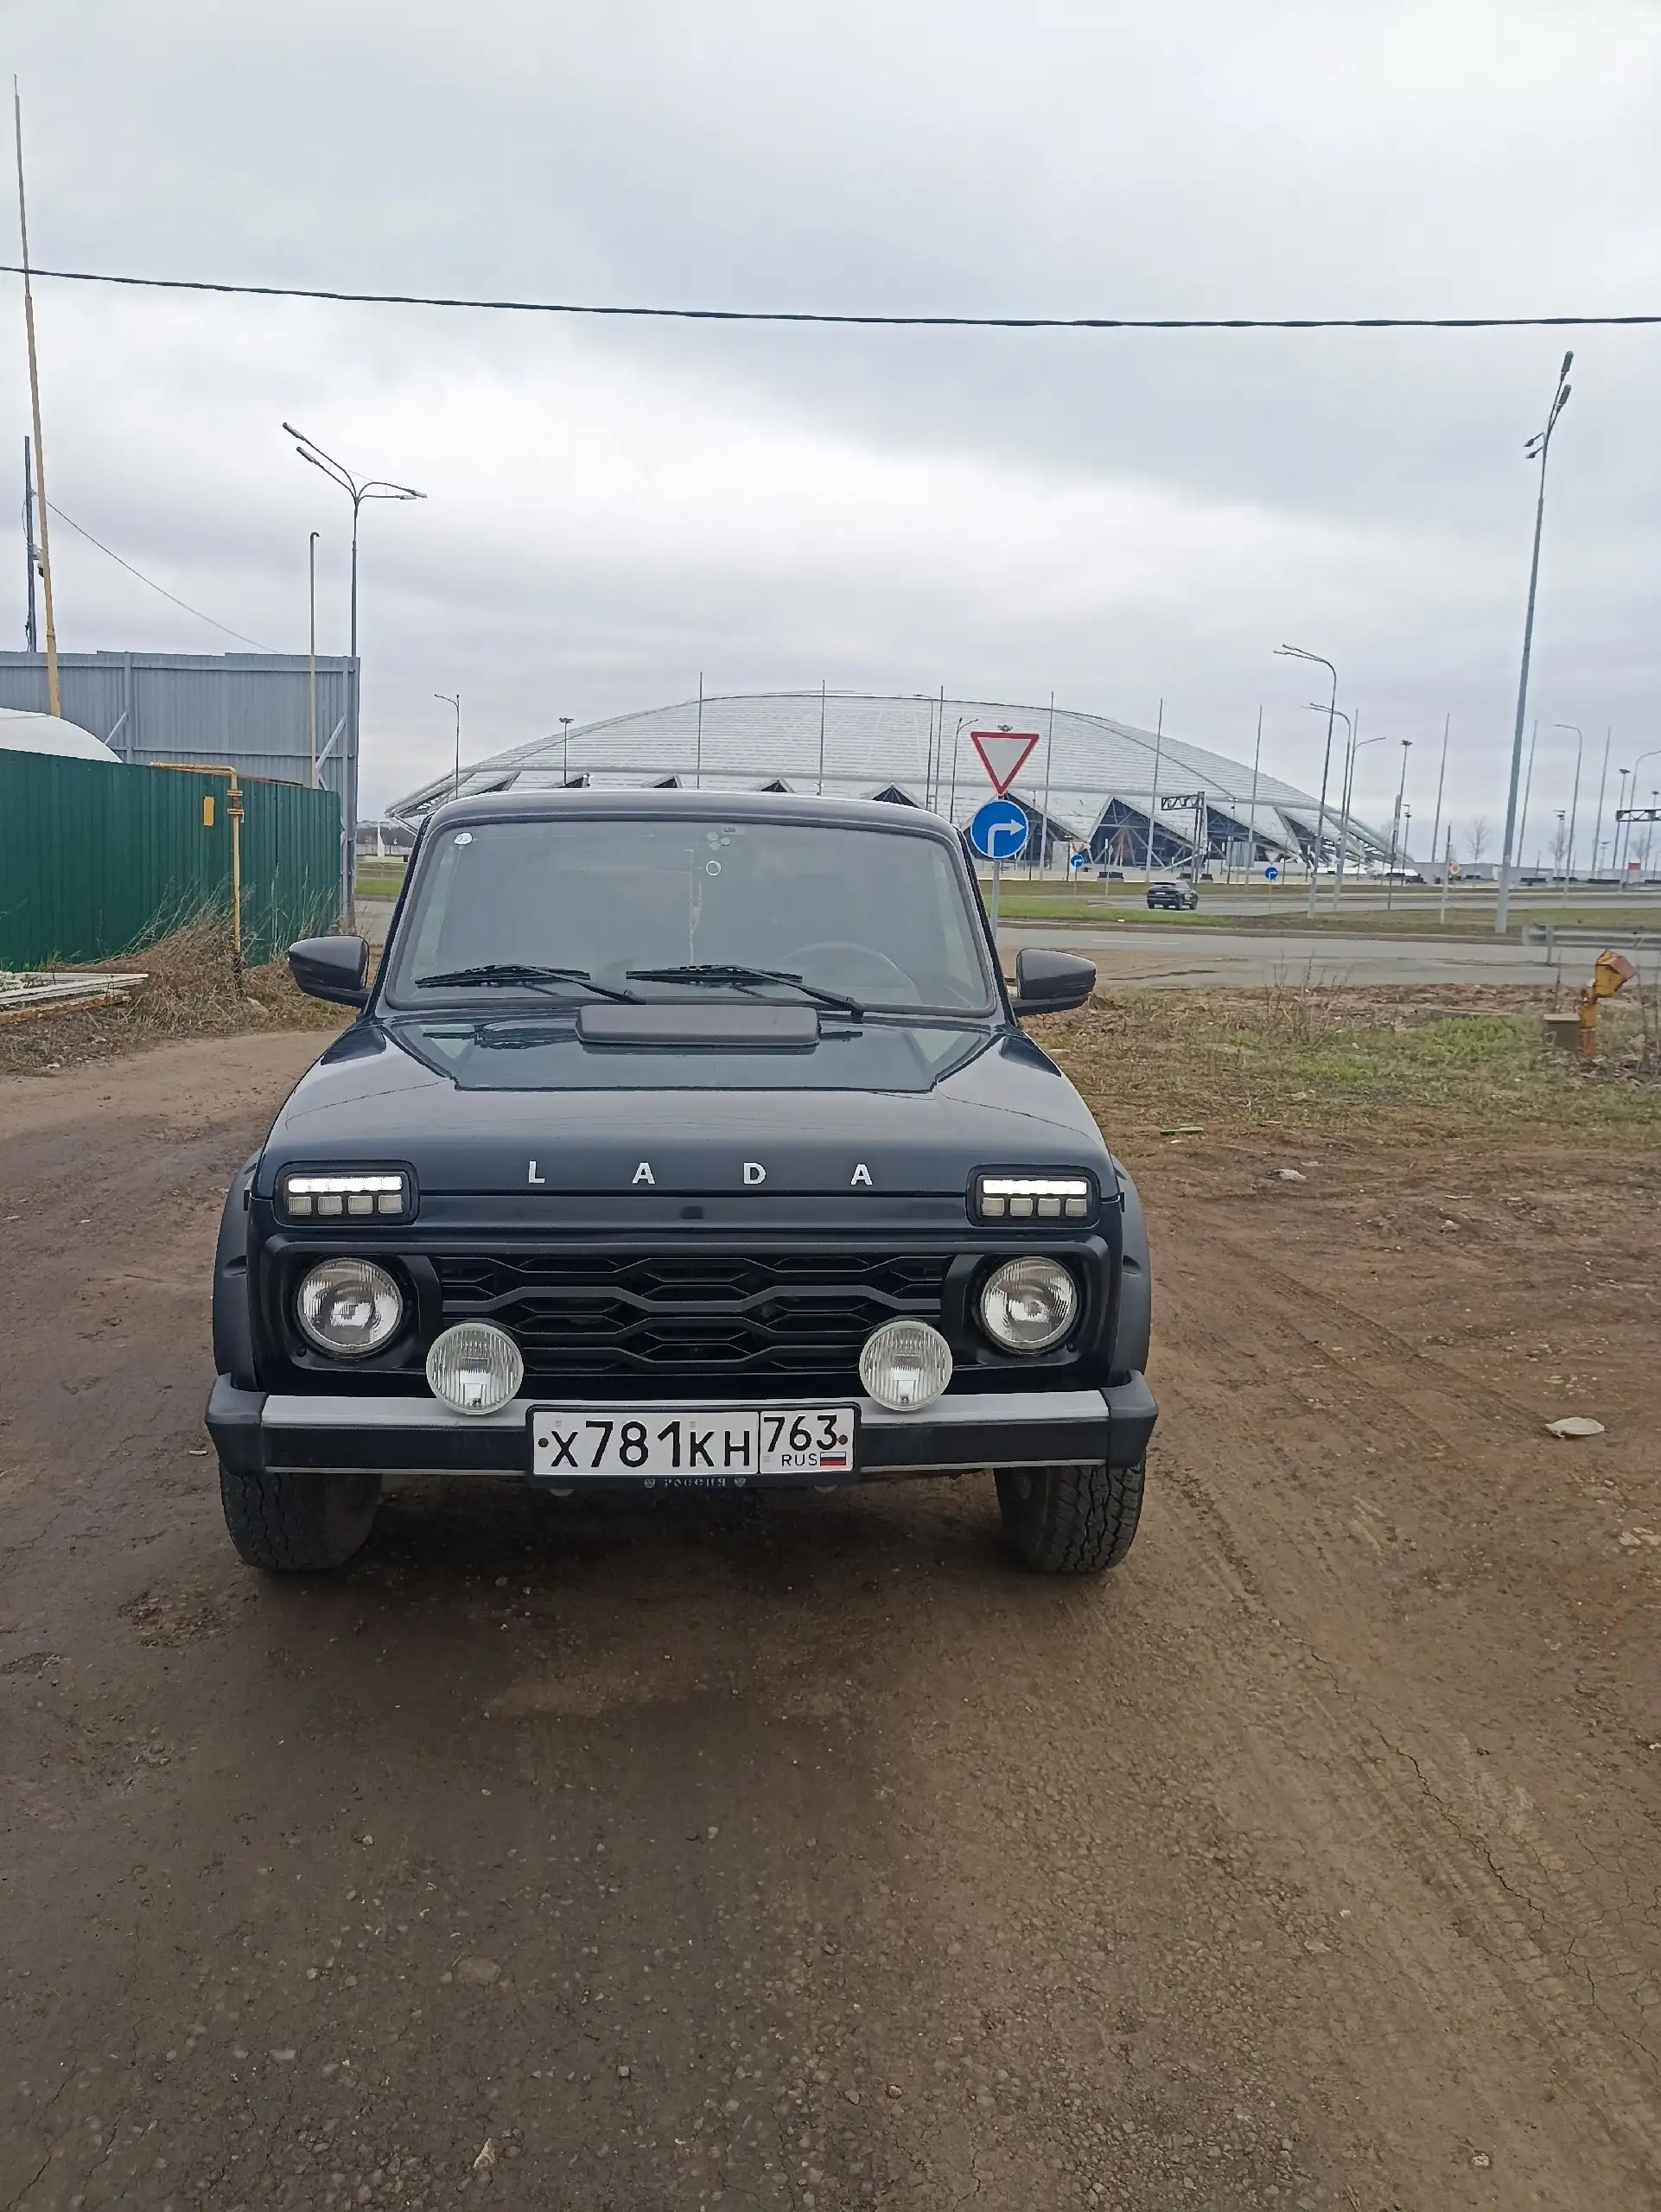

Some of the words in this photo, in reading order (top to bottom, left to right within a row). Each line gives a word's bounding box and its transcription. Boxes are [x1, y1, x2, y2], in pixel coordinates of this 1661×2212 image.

[528, 1160, 873, 1185] LADA
[763, 1414, 838, 1452] 763
[781, 1452, 817, 1466] RUS
